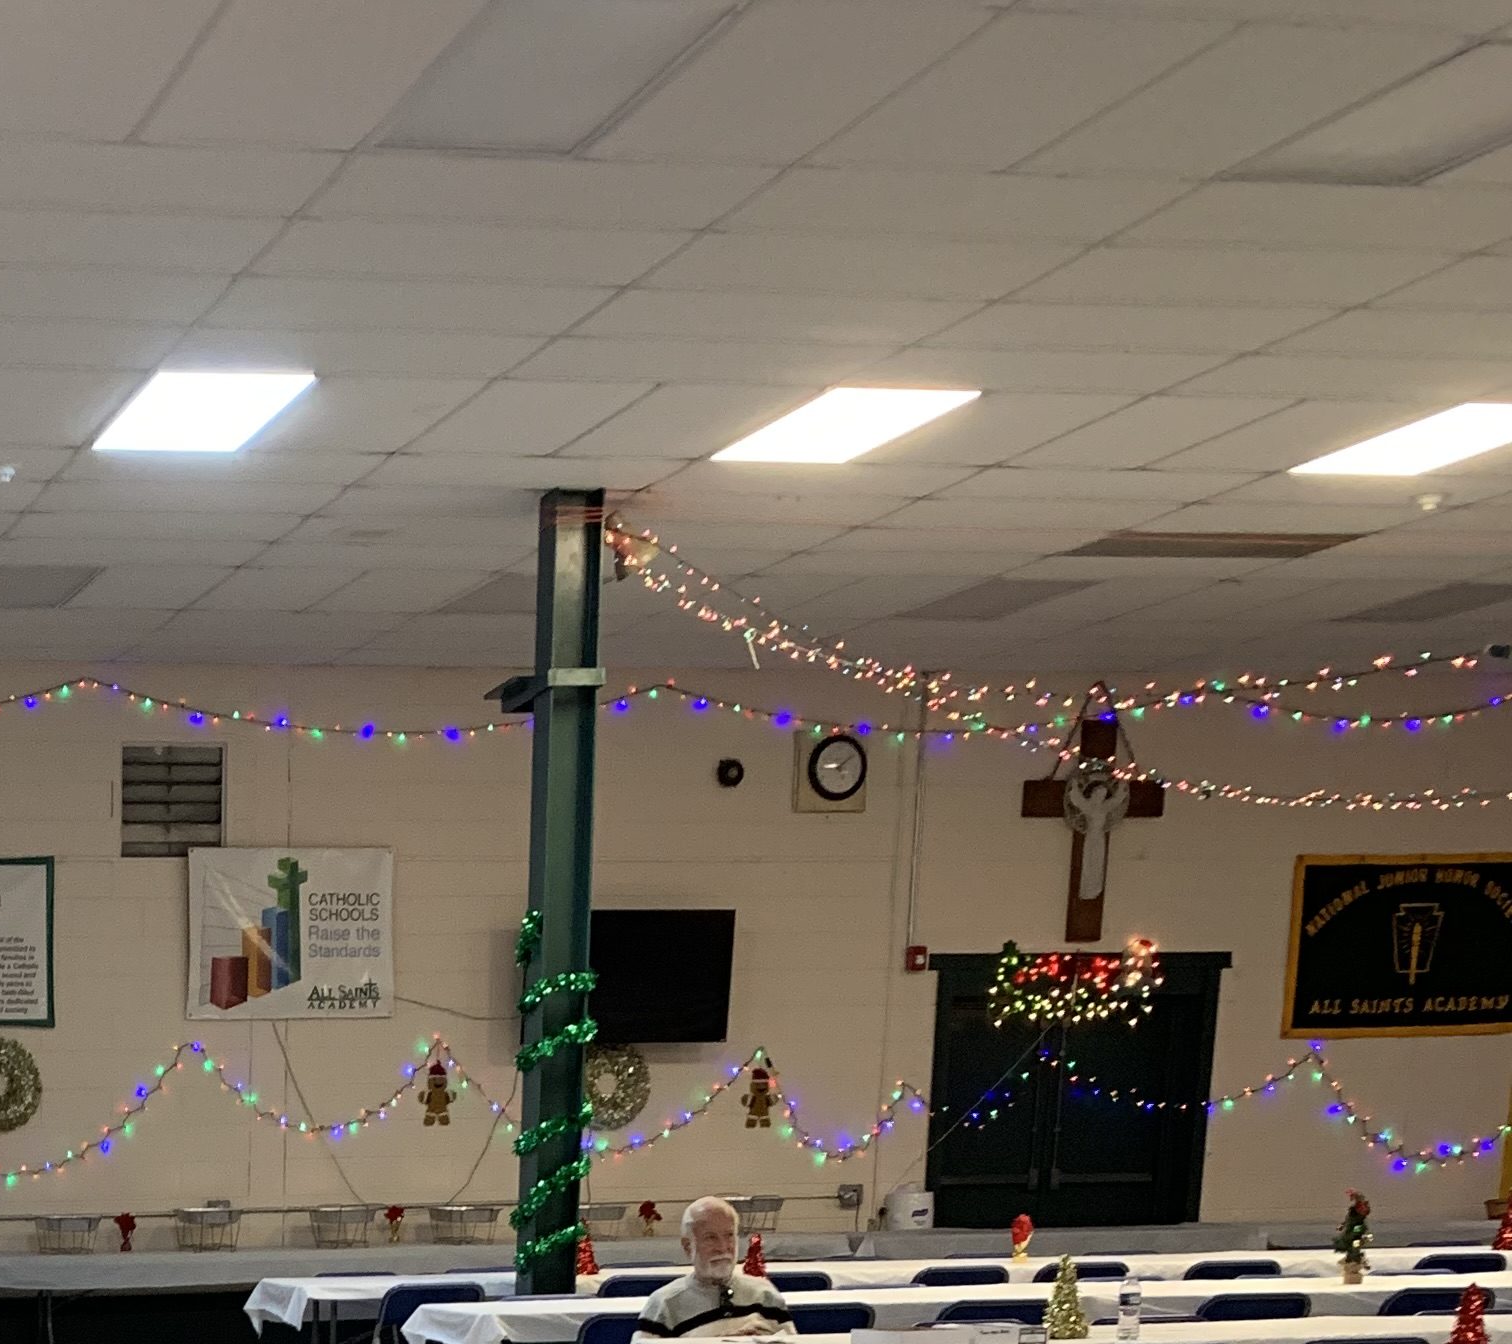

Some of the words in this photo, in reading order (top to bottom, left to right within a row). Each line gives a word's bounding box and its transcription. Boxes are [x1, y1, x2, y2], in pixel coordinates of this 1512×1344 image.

[308, 892, 380, 906] CATHOLIC
[309, 908, 379, 921] SCHOOLS
[308, 925, 350, 940] Raise
[356, 926, 380, 940] the
[308, 943, 380, 958] Standards
[307, 985, 335, 1001] ALL
[307, 1001, 378, 1010] ACADEMY
[1309, 999, 1342, 1015] ALL
[1349, 997, 1414, 1014] SAINTS
[1422, 994, 1511, 1013] ACADEMY
